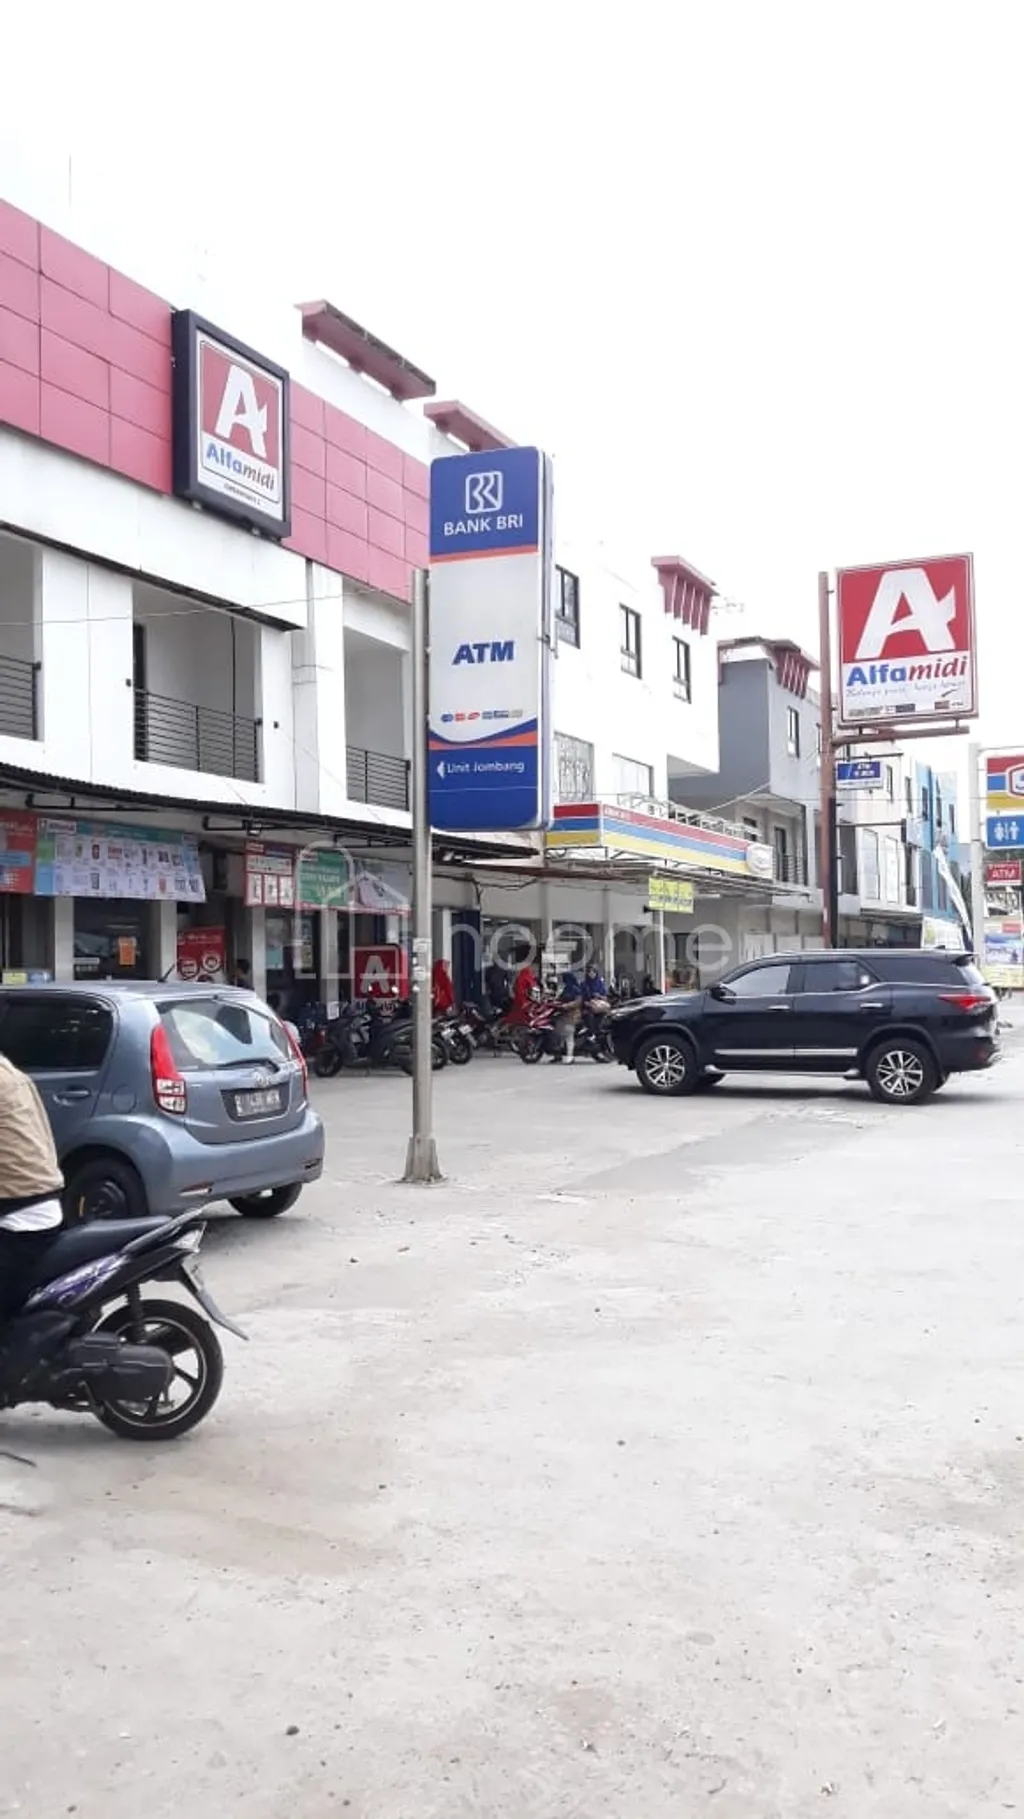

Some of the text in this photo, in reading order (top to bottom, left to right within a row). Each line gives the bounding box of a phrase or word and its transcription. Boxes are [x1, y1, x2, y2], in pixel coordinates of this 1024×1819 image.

[206, 442, 275, 491] Alfamidi
[444, 514, 524, 536] BANK BRI
[451, 641, 515, 665] ATM
[846, 655, 968, 687] Alfamidi
[447, 761, 525, 774] Unit Jombang
[991, 868, 1015, 879] ATM
